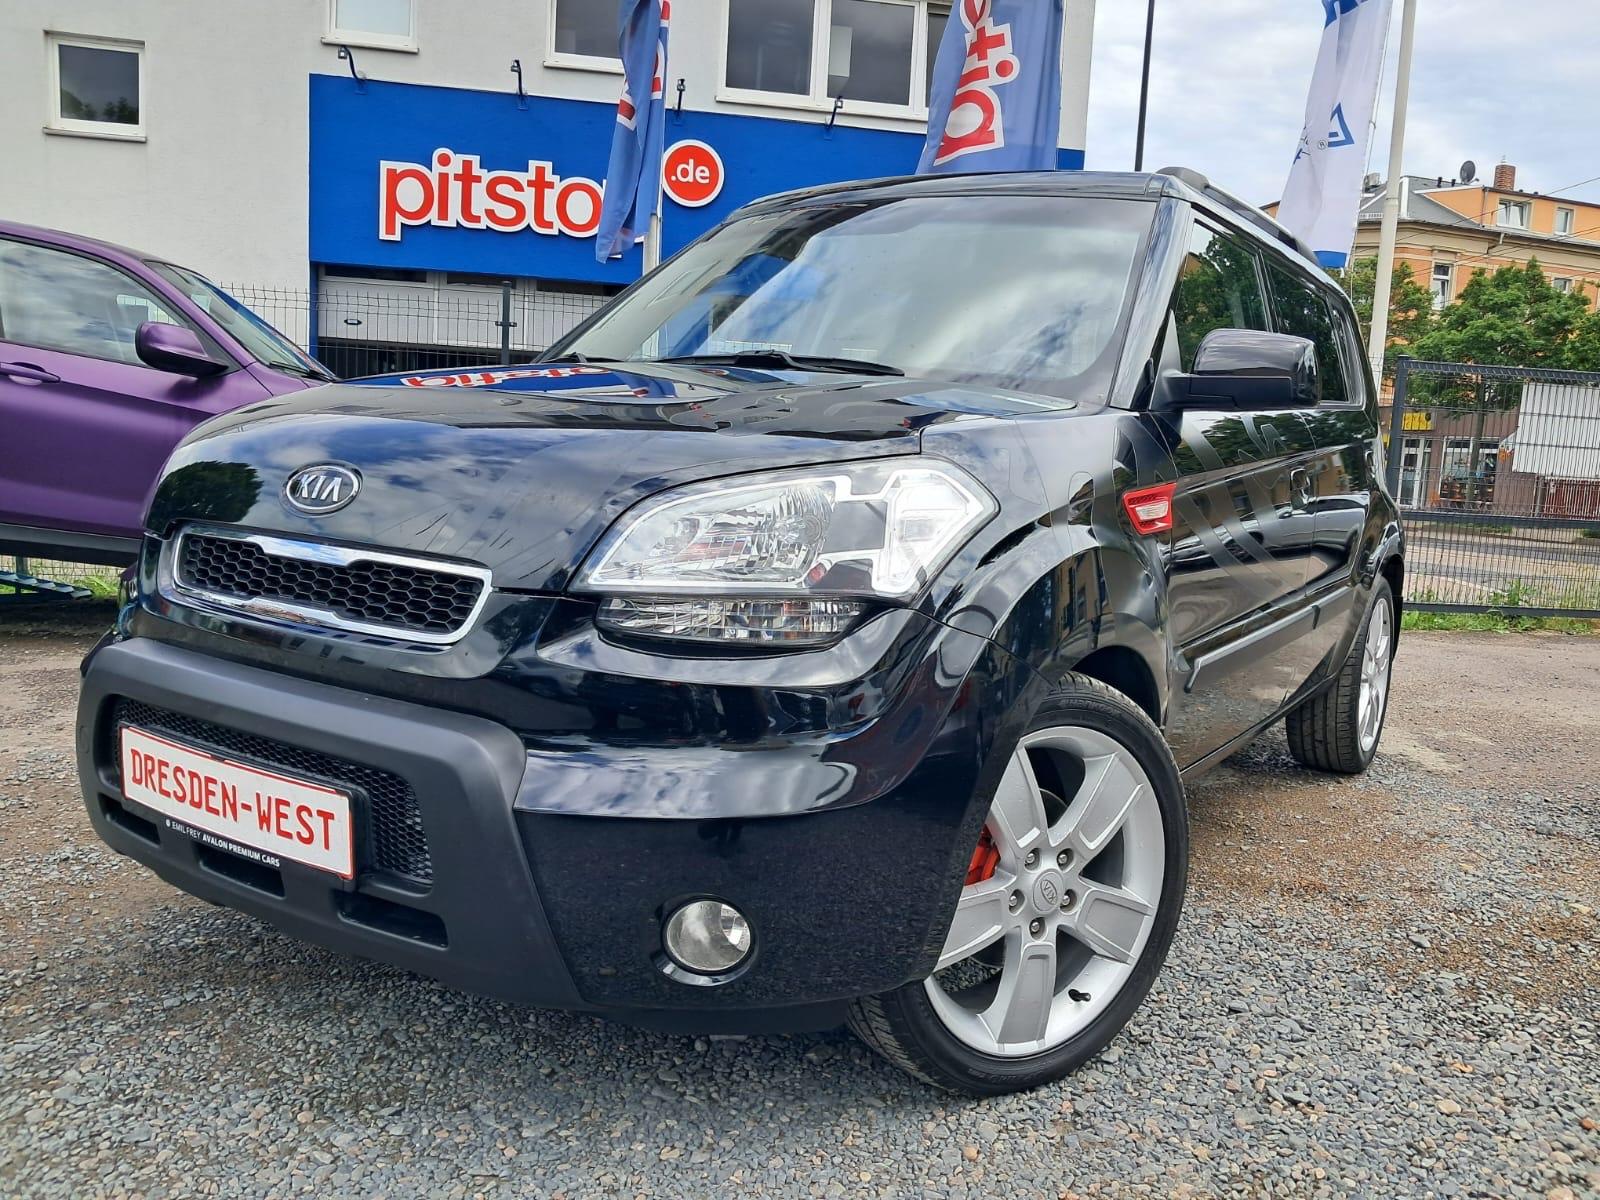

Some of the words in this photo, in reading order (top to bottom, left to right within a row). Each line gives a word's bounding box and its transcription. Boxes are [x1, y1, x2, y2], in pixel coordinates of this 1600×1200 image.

[382, 151, 605, 238] pitsto
[670, 158, 710, 184] .de
[296, 473, 342, 502] KIA
[130, 748, 335, 850] DRESDEN-WEST
[171, 822, 186, 834] EMIL
[186, 828, 201, 839] FREY
[202, 834, 228, 850] AVALON
[229, 843, 261, 860] PREMIUM
[261, 854, 280, 867] CARS
